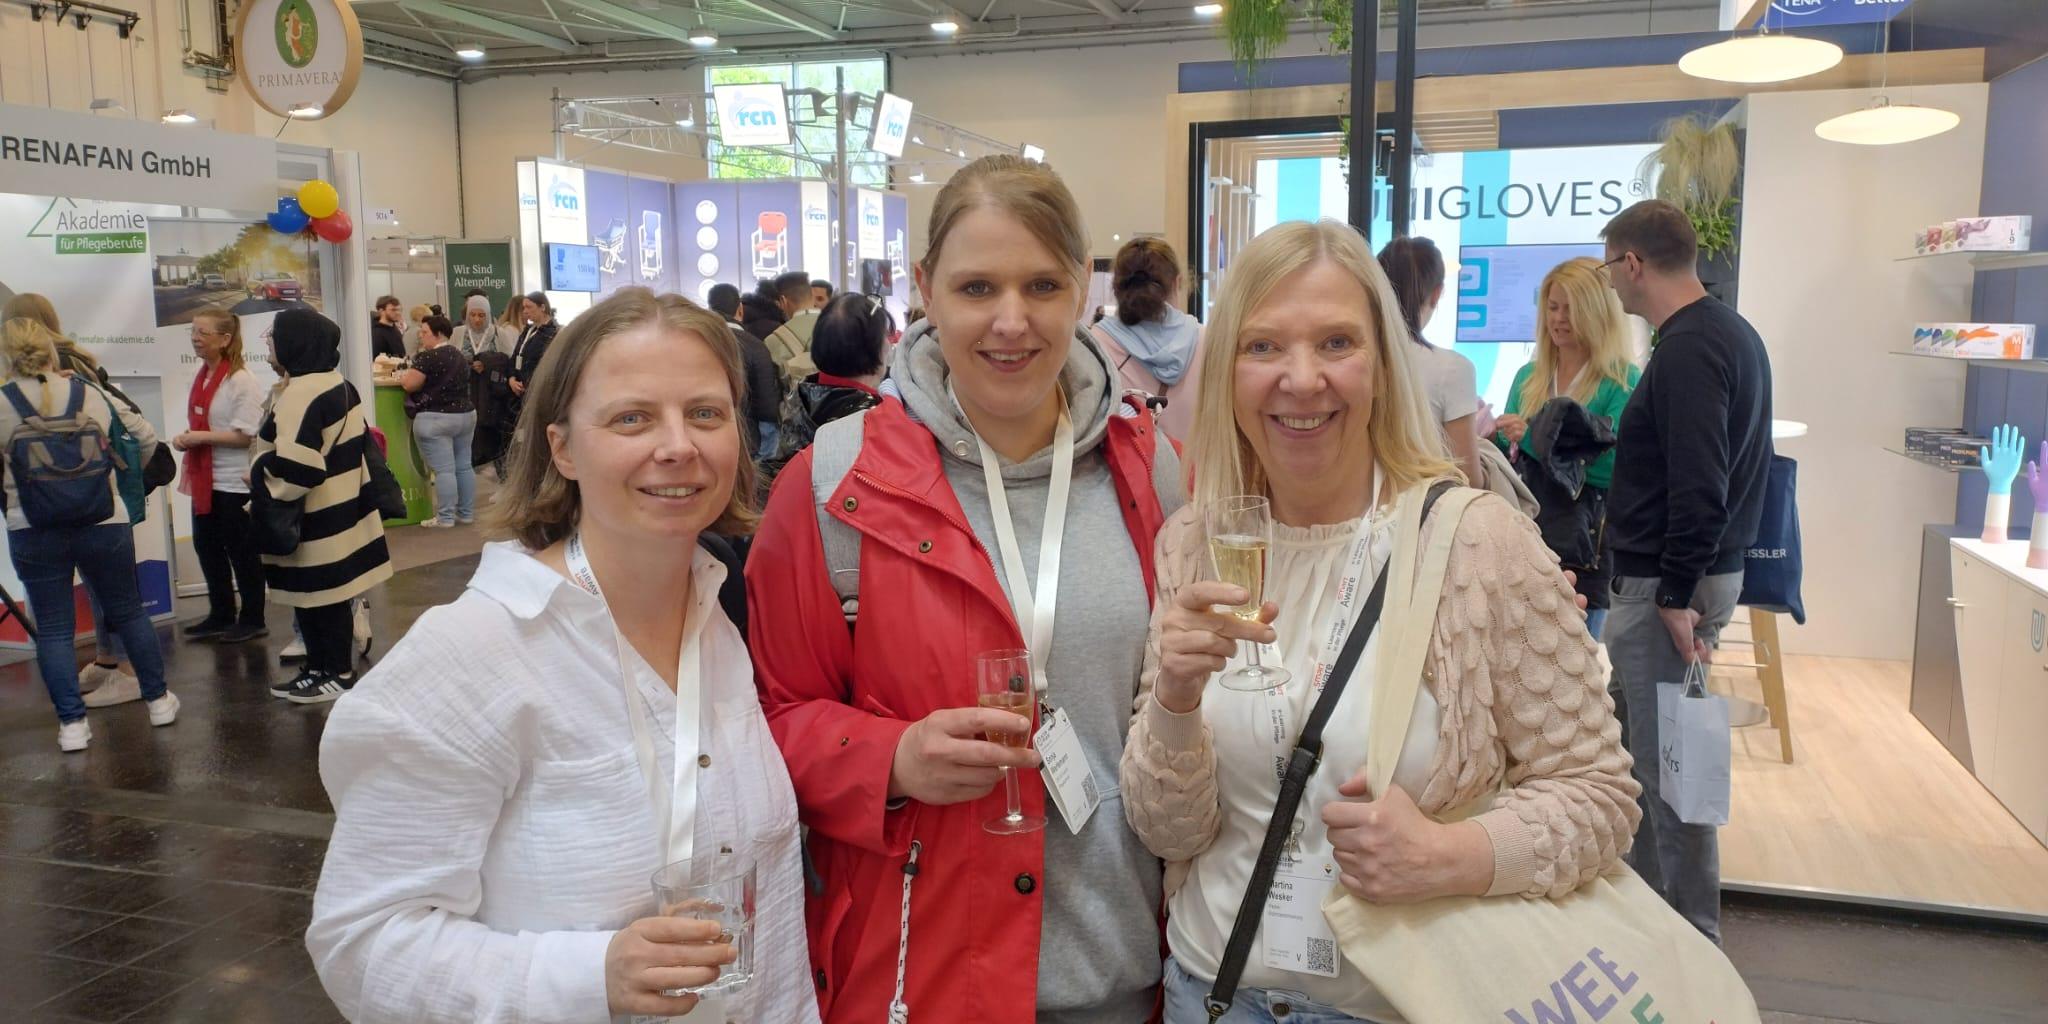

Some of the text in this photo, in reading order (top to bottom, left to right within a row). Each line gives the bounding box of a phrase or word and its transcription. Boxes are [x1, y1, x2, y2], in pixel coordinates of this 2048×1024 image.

[736, 108, 777, 126] rcn
[887, 119, 904, 139] rcn
[1, 135, 211, 178] RENAFAN GmbH
[553, 190, 579, 210] rcn
[56, 209, 145, 230] Akademie
[60, 235, 144, 251] für Pflegeberufe
[453, 264, 493, 274] Wir Sind
[454, 277, 506, 289] Altenpflege
[1340, 576, 1356, 608] Aware
